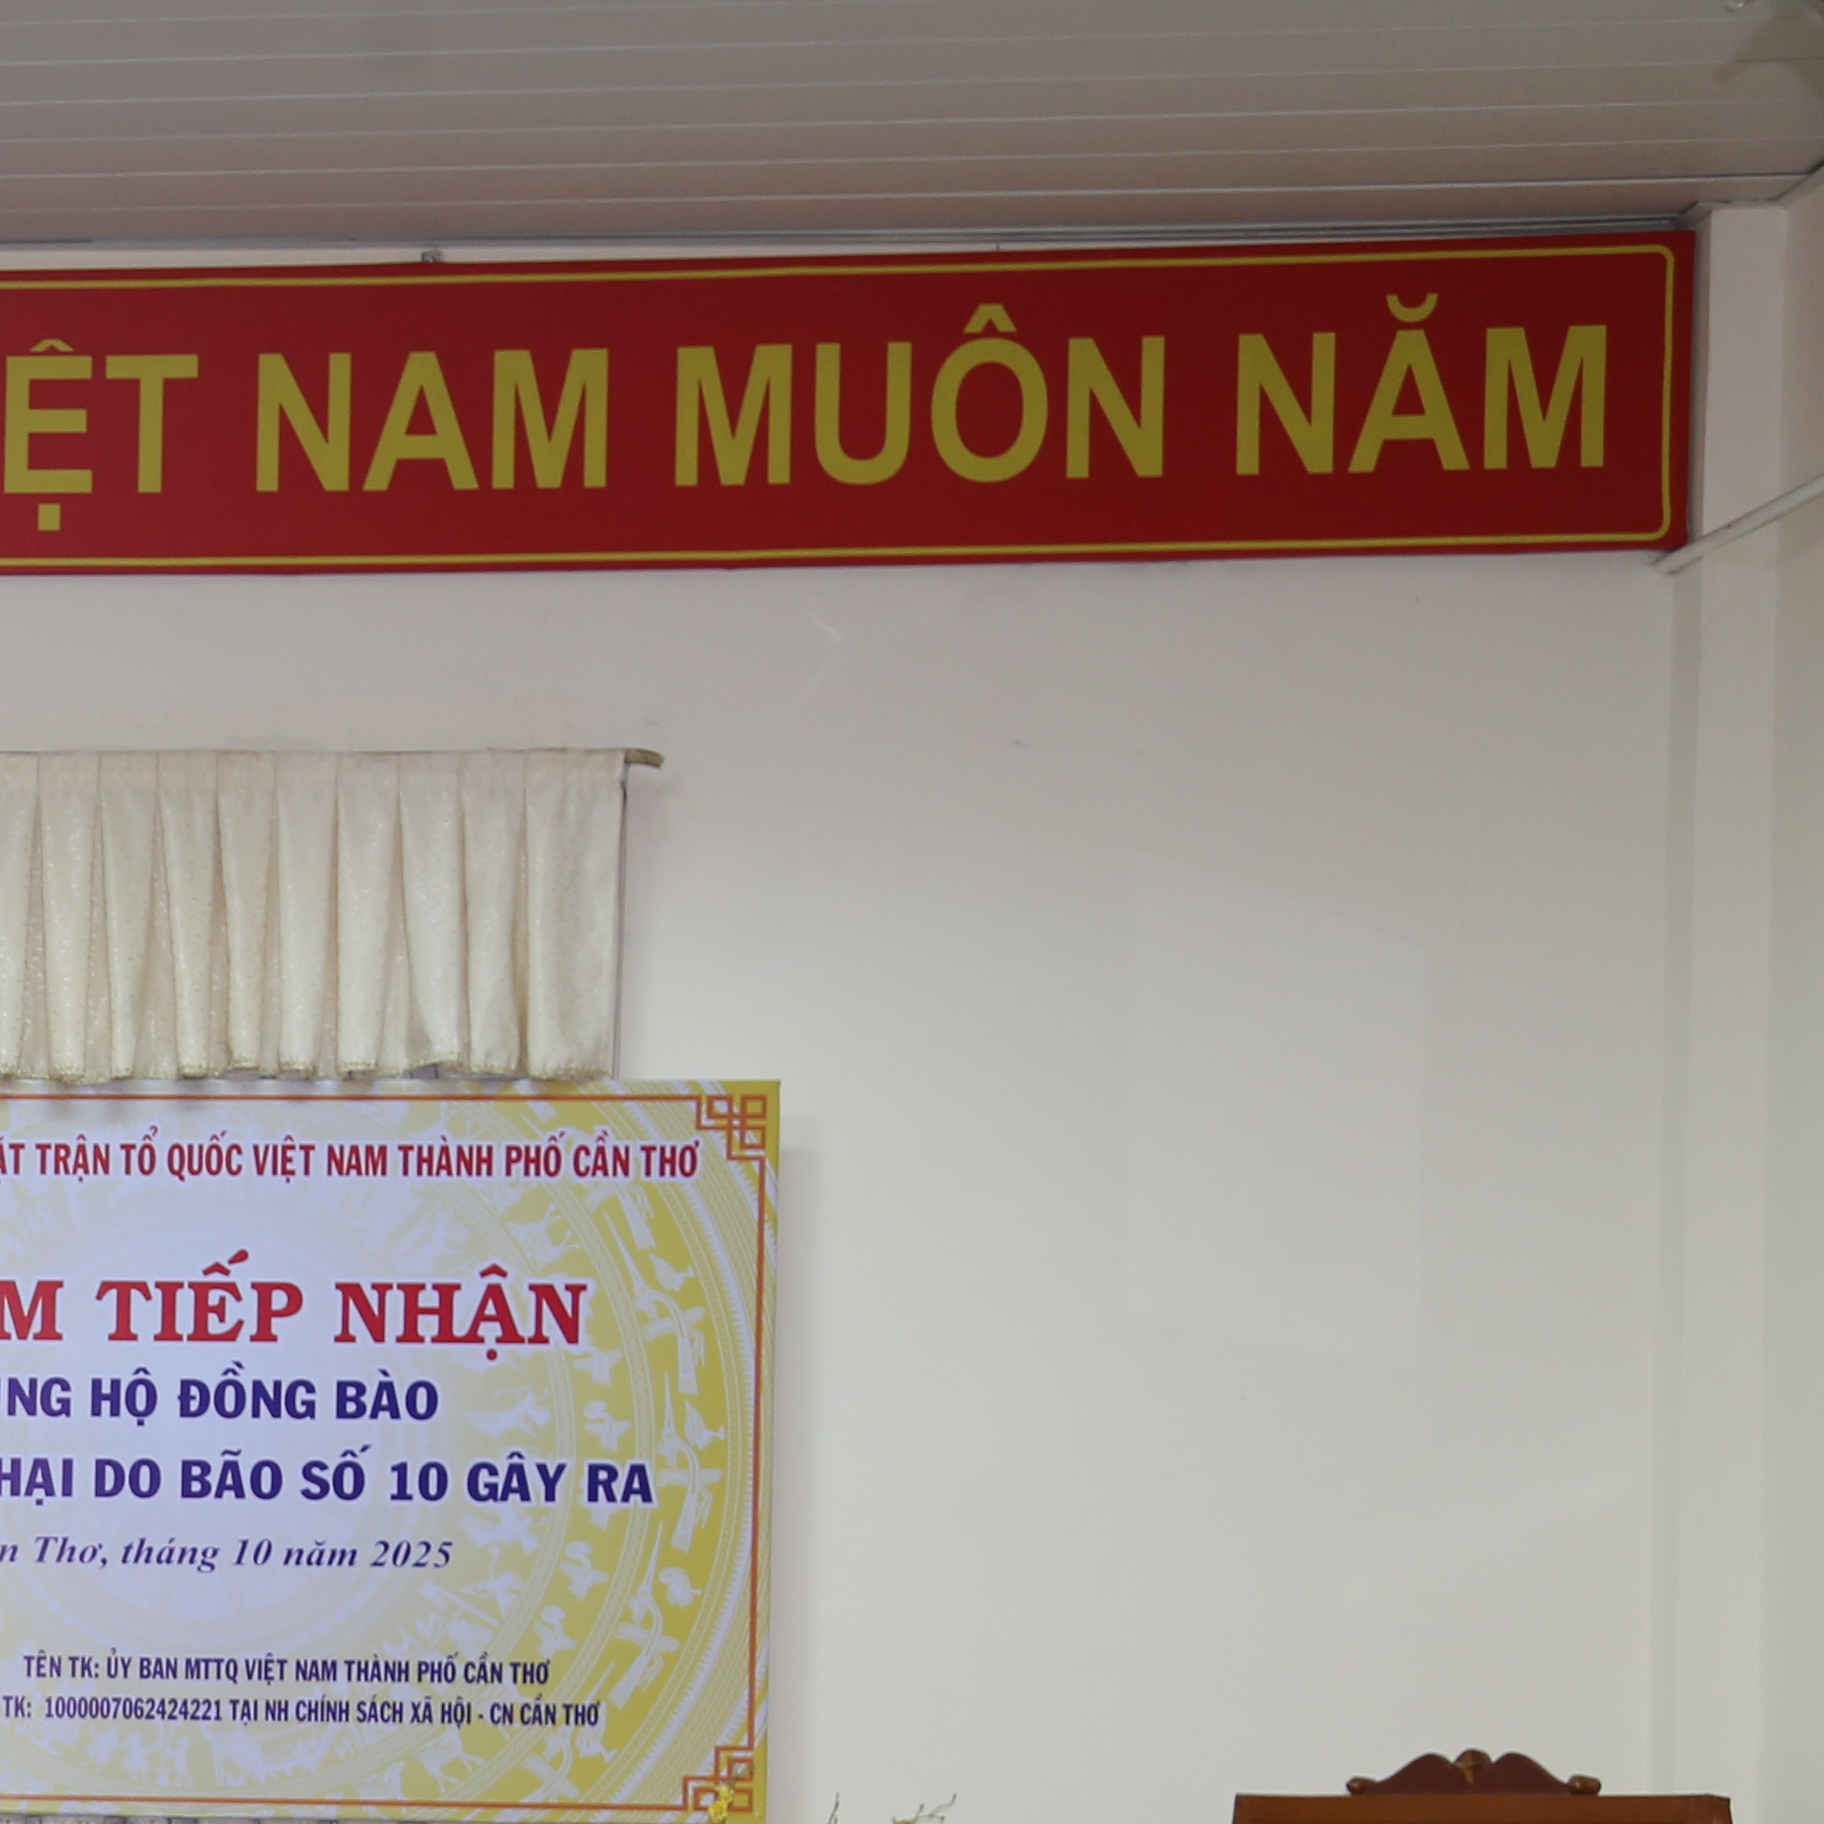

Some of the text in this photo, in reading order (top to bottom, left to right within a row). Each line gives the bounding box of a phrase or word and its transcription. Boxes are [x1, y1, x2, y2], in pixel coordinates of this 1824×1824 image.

[255, 347, 609, 493] NAM
[674, 303, 1166, 487] MUÔN
[1236, 293, 1608, 475] NĂM
[36, 1134, 111, 1182] TRẬN
[121, 1125, 158, 1176] TỔ
[167, 1130, 244, 1181] QUỐC
[253, 1135, 316, 1183] VIỆT
[326, 1144, 388, 1177] NAM
[398, 1136, 494, 1178] THÀNH
[505, 1131, 566, 1178] PHỐ
[573, 1129, 630, 1178] CẦN
[641, 1140, 700, 1178] THƠ
[97, 1250, 305, 1343] TIẾP
[335, 1264, 589, 1360] NHẬN
[90, 1368, 160, 1428] HỘ
[177, 1360, 319, 1421] ĐỒNG
[335, 1366, 441, 1422] BÀO
[93, 1458, 162, 1499] DO
[179, 1448, 284, 1501] BÃO
[298, 1445, 376, 1502] SỐ
[390, 1461, 450, 1503] 10
[465, 1450, 570, 1506] GÂY
[586, 1461, 656, 1506] RA
[34, 1535, 109, 1568] Thơ,
[121, 1537, 220, 1573] tháng
[232, 1538, 273, 1567] 10
[284, 1540, 359, 1569] năm
[369, 1540, 455, 1570] 2025
[23, 1648, 552, 1687] TÊN TK: ỦY BAN MTTQ VIỆT NAM THÀNH PHỐ CẦN THƠ
[3, 1696, 33, 1719] TK:
[45, 1696, 224, 1721] 1000007062424221
[229, 1699, 259, 1727] TẠI
[264, 1700, 289, 1723] NH
[295, 1694, 351, 1724] CHÍNH
[356, 1694, 405, 1725] SÁCH
[410, 1696, 434, 1726] XÃ
[440, 1697, 473, 1729] HỘI
[489, 1702, 515, 1726] CN
[519, 1692, 558, 1728] CẦN
[563, 1700, 602, 1728] THƠ
